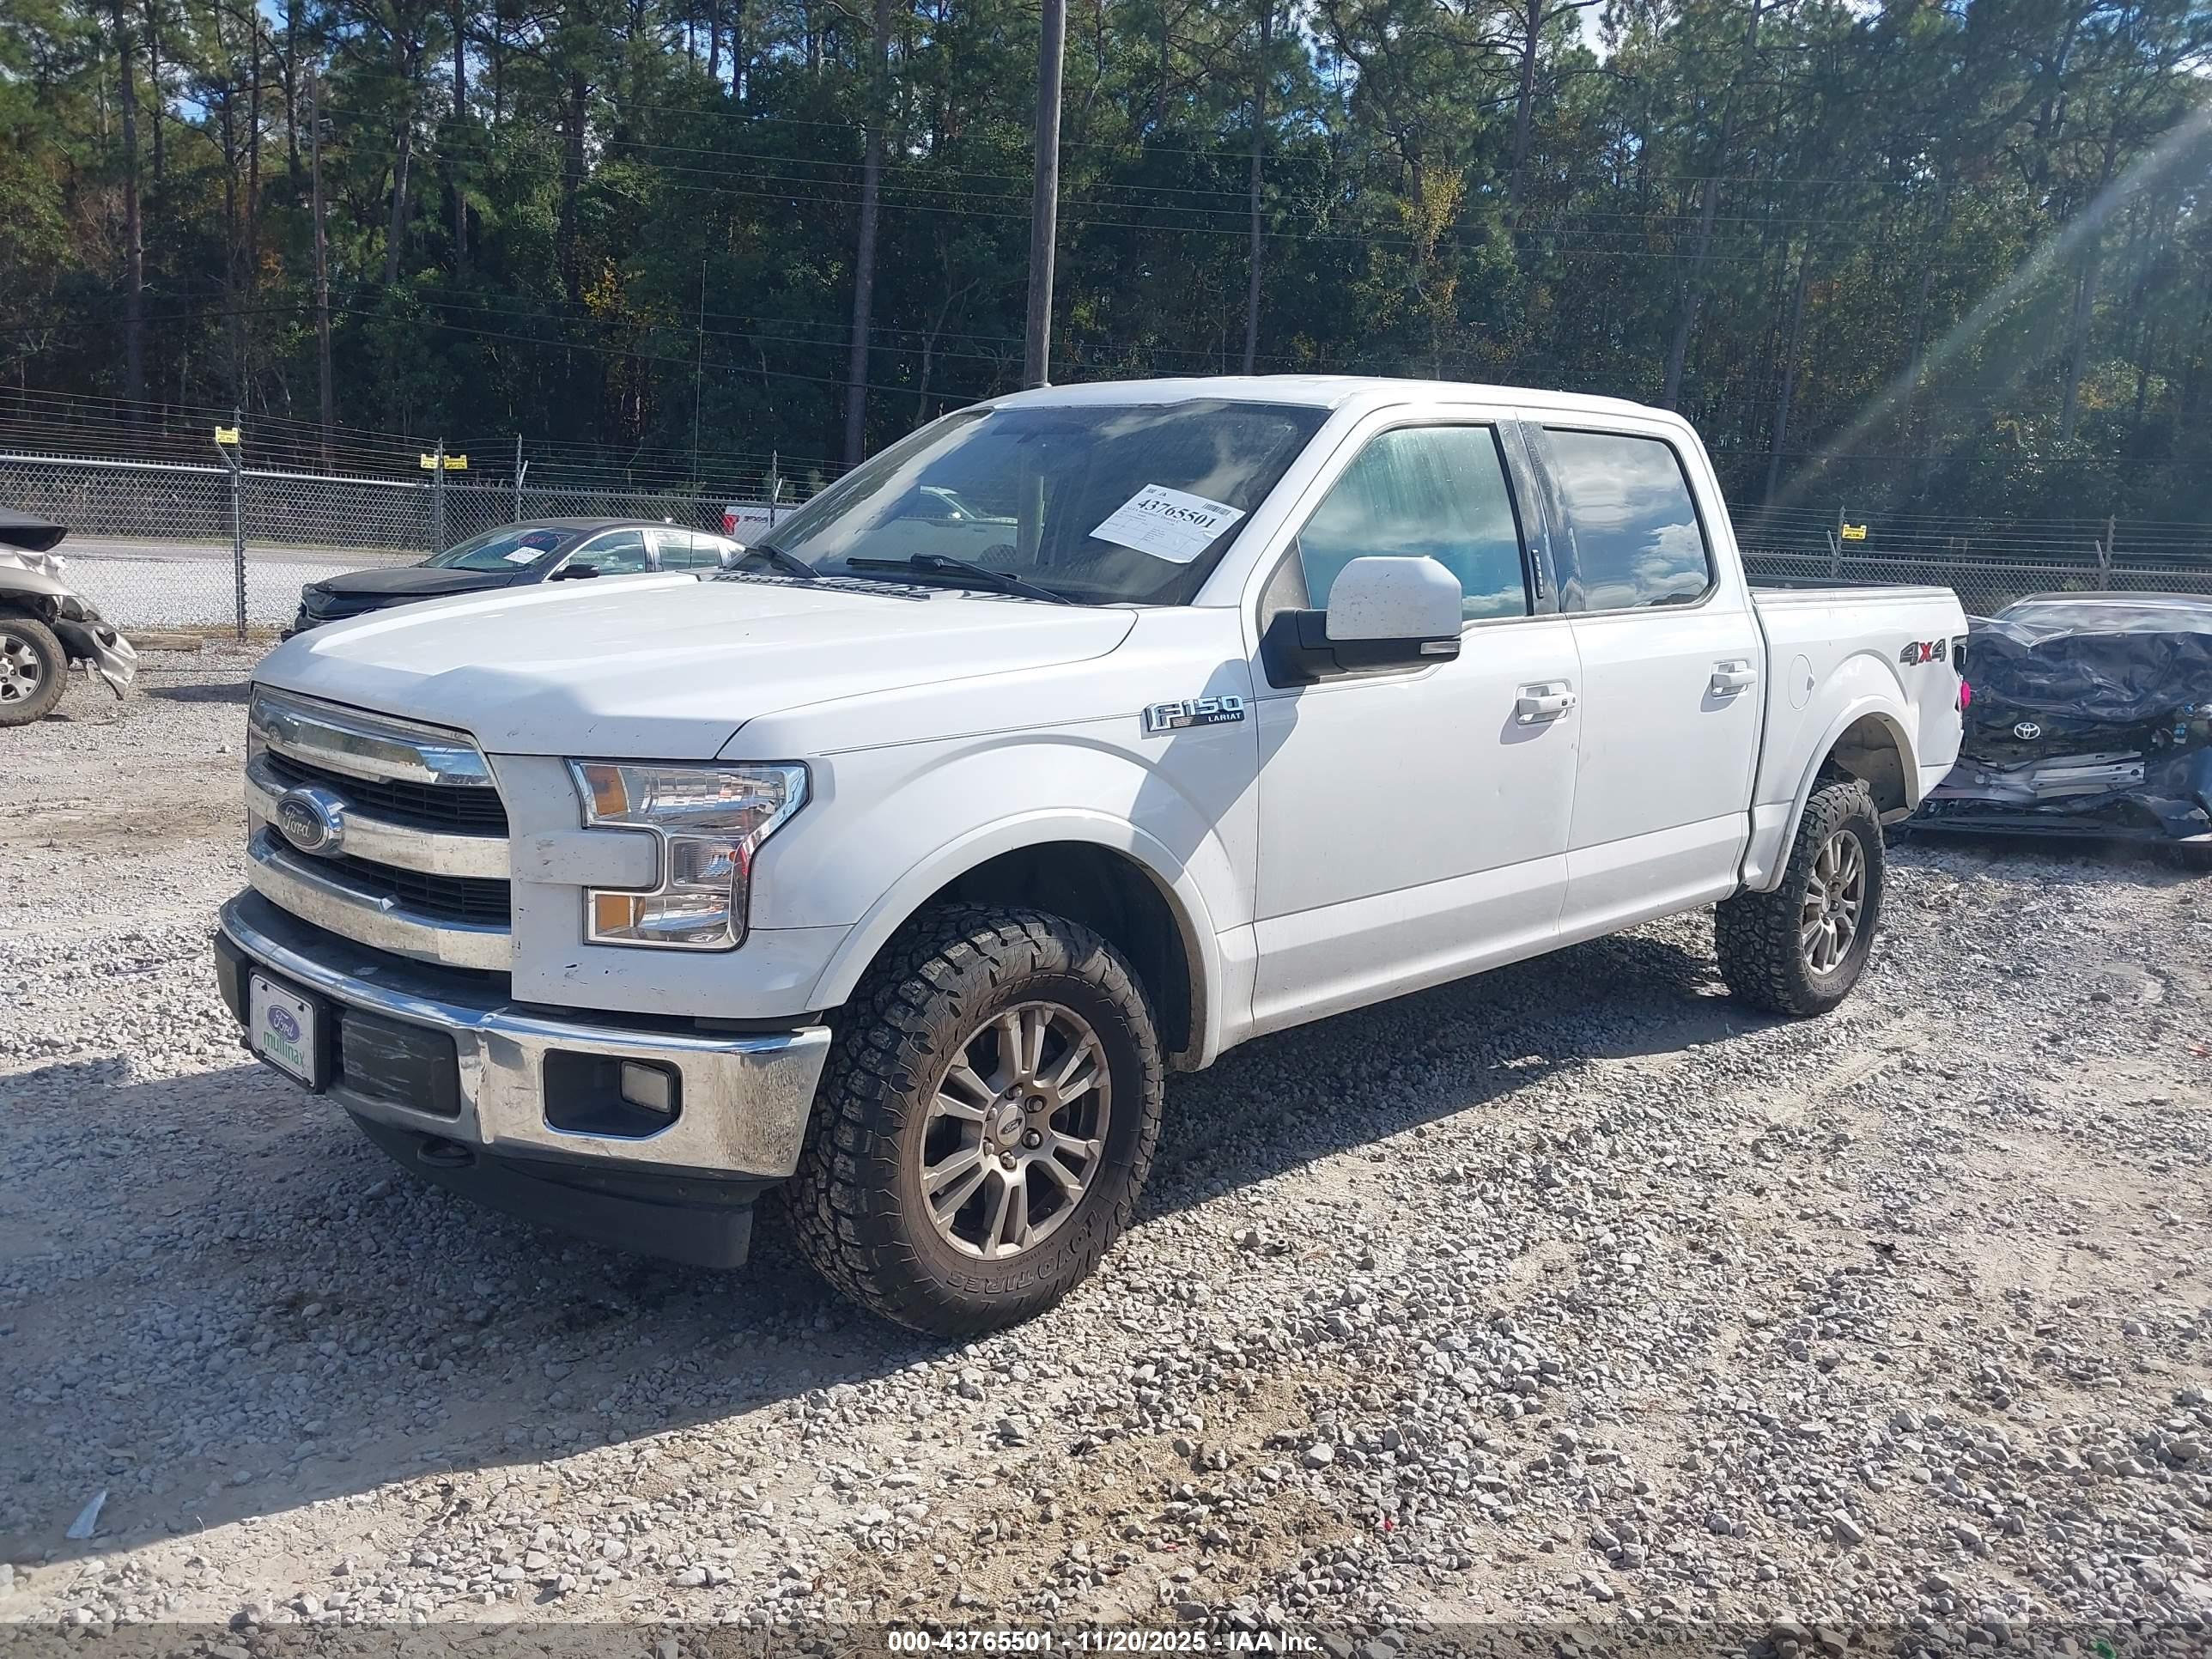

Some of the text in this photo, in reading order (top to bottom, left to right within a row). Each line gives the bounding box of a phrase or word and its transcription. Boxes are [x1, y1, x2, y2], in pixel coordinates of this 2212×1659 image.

[1138, 498, 1218, 529] 43765501
[1207, 712, 1242, 722] LARIAT
[283, 804, 312, 838] Ford
[273, 1009, 294, 1038] Ford
[946, 1269, 1035, 1295] TIRES
